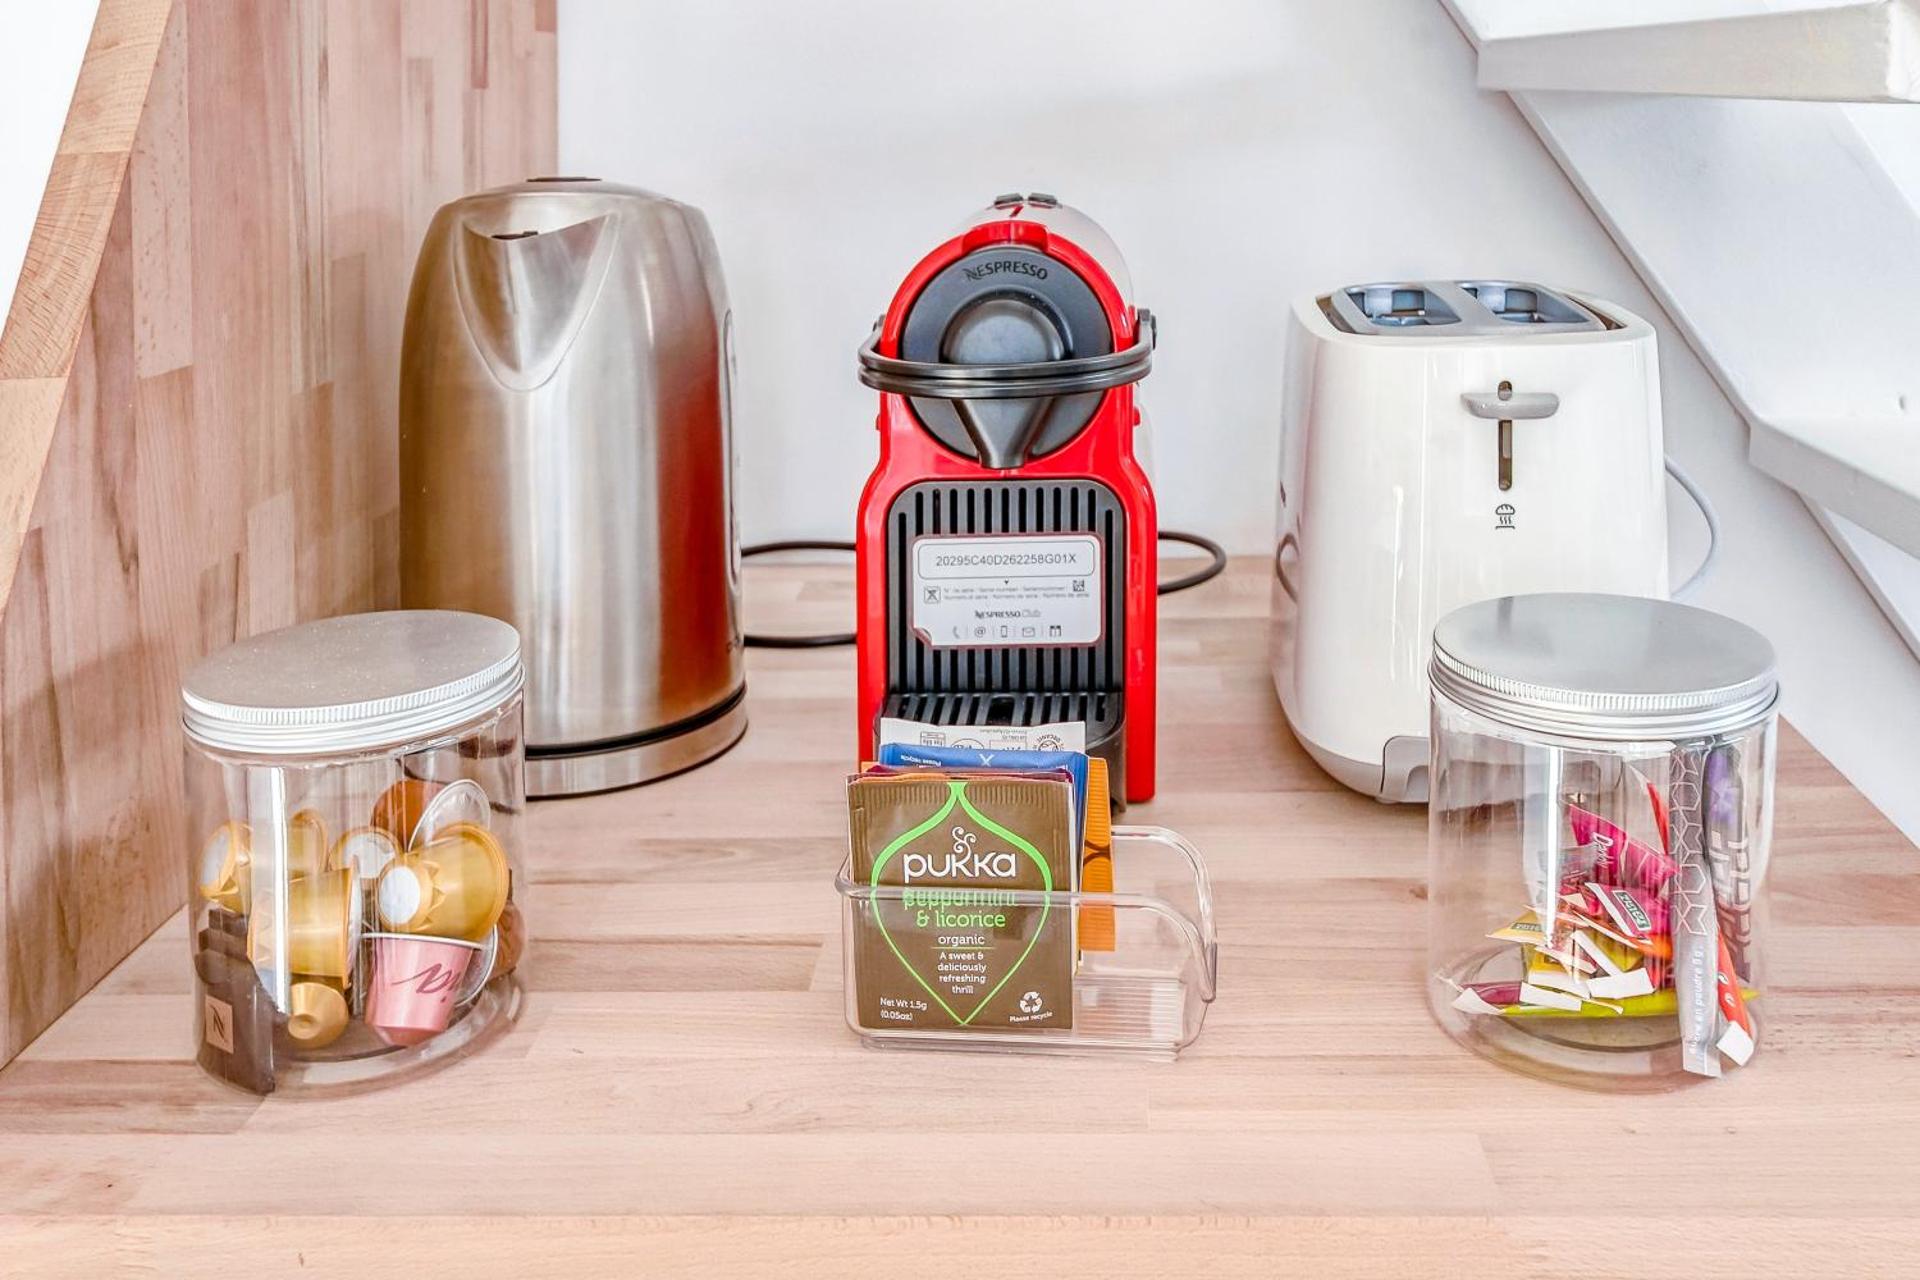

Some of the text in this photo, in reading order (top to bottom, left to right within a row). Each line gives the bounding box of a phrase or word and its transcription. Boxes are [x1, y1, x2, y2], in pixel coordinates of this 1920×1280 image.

[962, 260, 1049, 281] NESPRESSO
[903, 851, 1016, 884] pukka
[916, 910, 1006, 928] & licorice
[937, 933, 985, 949] organic
[939, 951, 947, 960] A
[948, 952, 974, 960] sweet
[937, 962, 987, 974] deliciously
[938, 973, 986, 984] refreshing
[951, 984, 974, 995] thrill
[880, 997, 895, 1007] Net
